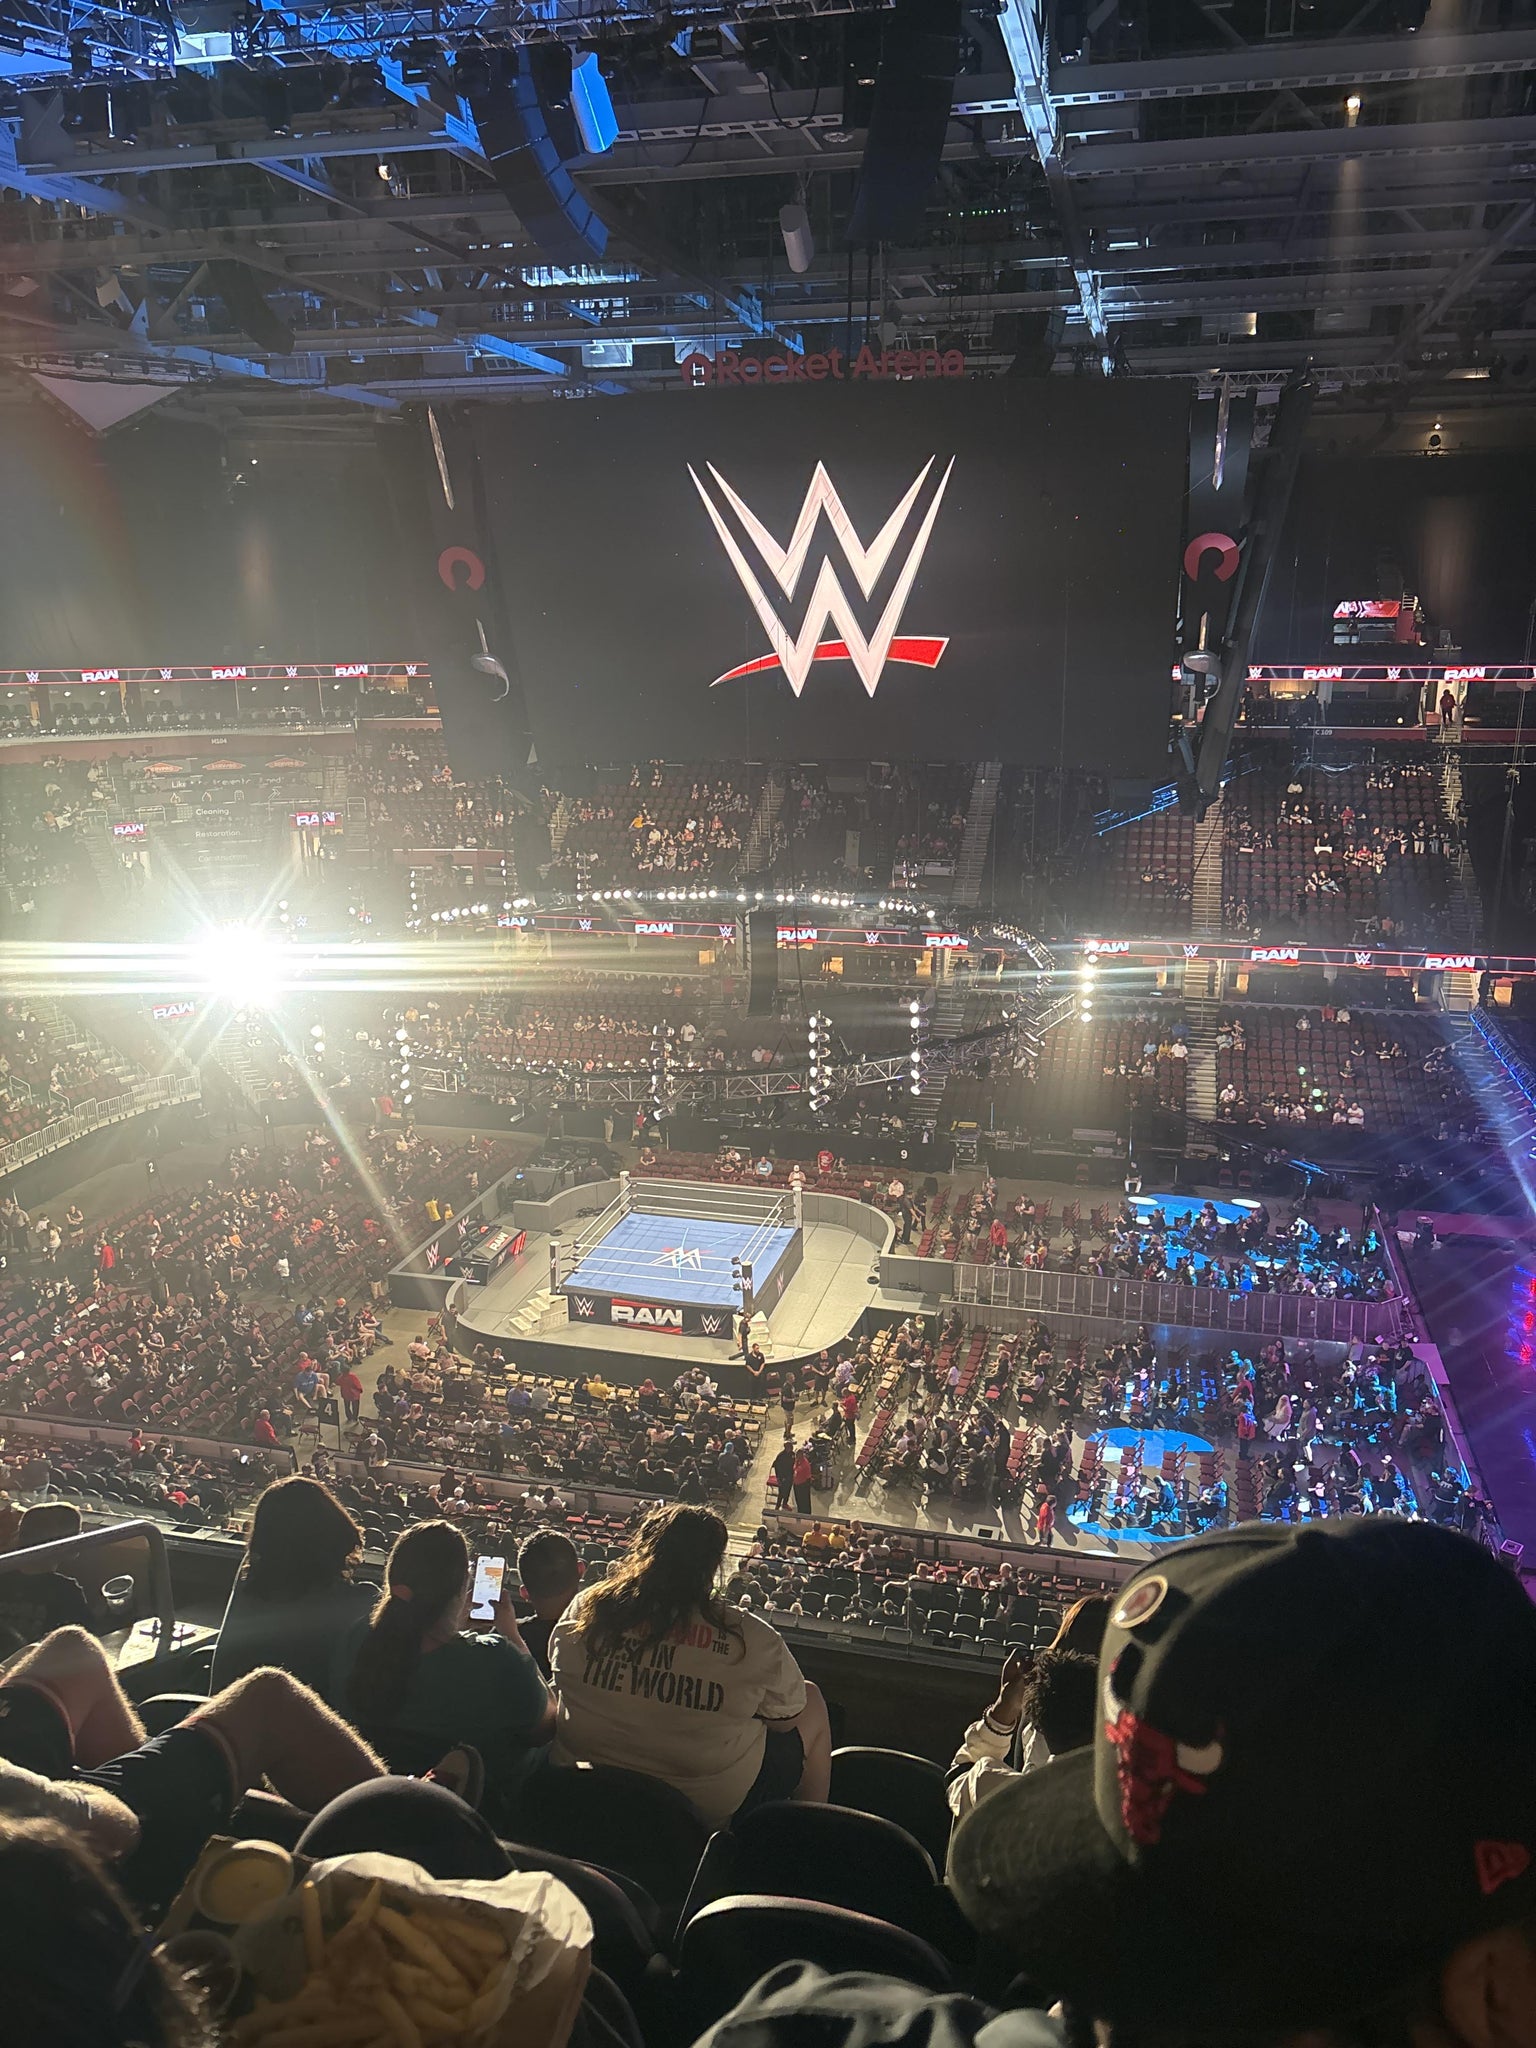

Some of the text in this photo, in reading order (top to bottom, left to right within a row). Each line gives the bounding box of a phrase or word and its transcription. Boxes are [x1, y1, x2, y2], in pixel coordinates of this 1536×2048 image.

[717, 345, 965, 384] Rocket Arena
[81, 669, 119, 682] RAW
[212, 666, 246, 679] RAW
[335, 664, 368, 677] RAW
[1303, 667, 1343, 680] RAW
[1445, 667, 1486, 680] RAW
[195, 807, 231, 816] Cleaning
[114, 823, 145, 835] RAW
[195, 829, 241, 838] Restoration
[635, 922, 674, 935] RAW
[777, 929, 818, 942] RAW
[1251, 947, 1299, 961] RAW
[1425, 956, 1475, 969] RAW
[153, 1001, 195, 1019] RAW
[900, 1149, 908, 1160] 9
[148, 1162, 155, 1173] 2
[489, 1231, 510, 1251] RAW
[0, 1256, 7, 1268] 3
[611, 1305, 682, 1327] RAW
[324, 1402, 333, 1417] 4
[711, 1639, 730, 1656] THE
[649, 1639, 677, 1670] IN
[583, 1654, 726, 1713] THE WORLD
